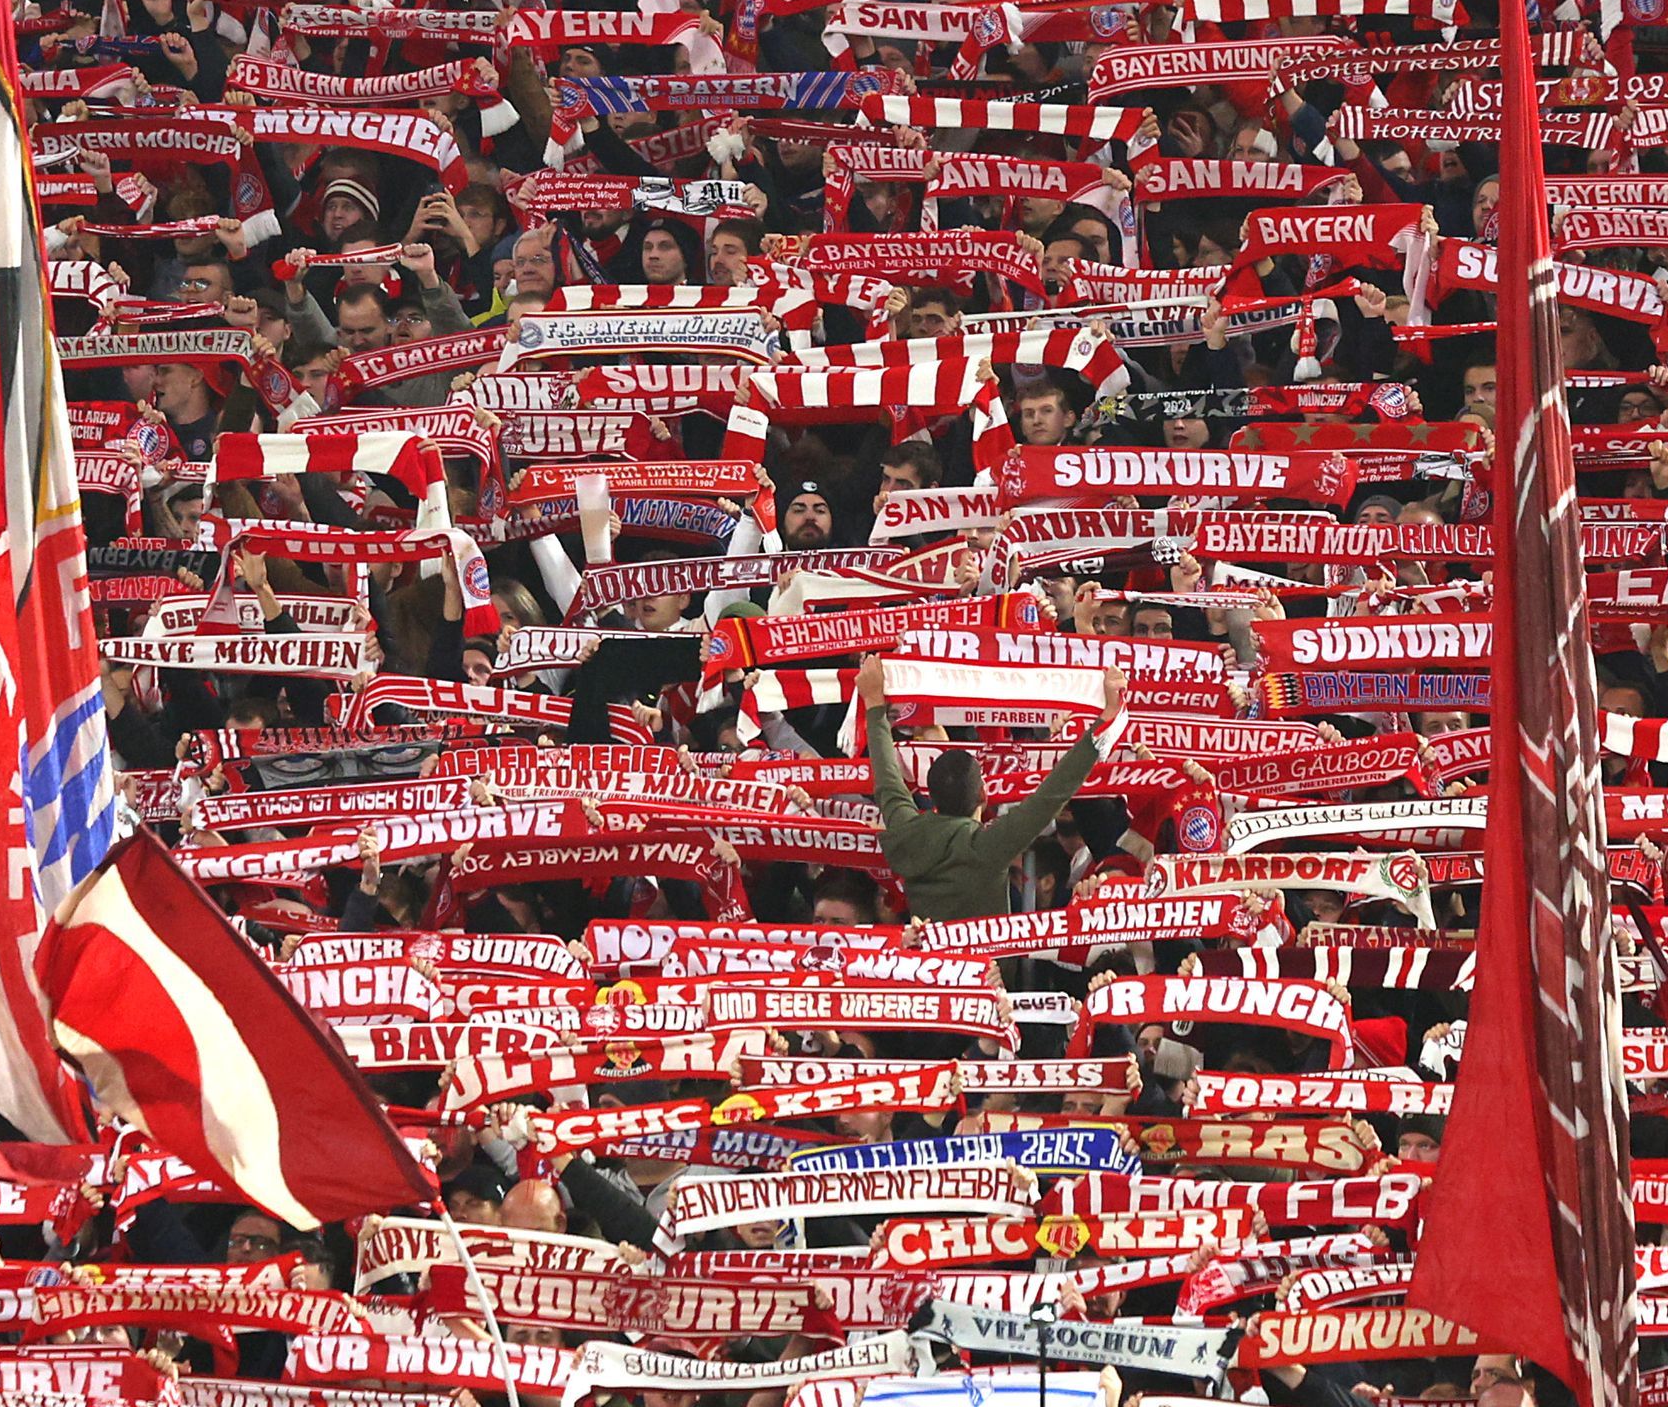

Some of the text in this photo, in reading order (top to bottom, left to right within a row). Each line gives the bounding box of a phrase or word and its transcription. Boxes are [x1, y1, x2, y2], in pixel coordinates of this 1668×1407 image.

[264, 64, 355, 96] BAYERN
[358, 60, 464, 97] MÜNCHEN
[254, 106, 461, 172] MÜNCHEN
[1008, 164, 1068, 192] MIA
[1258, 213, 1375, 244] BAYERN
[1563, 215, 1590, 241] FC
[561, 335, 753, 348] DEUTSCHER REKORDMEISTER
[603, 319, 676, 340] BAYERN
[680, 317, 769, 342] MÜNCHEN
[1054, 450, 1294, 490] SÜDKURVE
[214, 640, 362, 670] MÜNCHEN
[756, 763, 871, 783] SUPER REDS
[1299, 773, 1387, 789] NIEDERBAYERN
[1176, 858, 1371, 892] KLARDORF
[1080, 897, 1223, 932] MÜNCHEN
[713, 990, 924, 1023] UND SEELE UNSERES
[1022, 1133, 1096, 1166] ZEISS
[724, 1179, 774, 1214] DEN
[777, 1170, 906, 1208] MODERNEN
[1052, 1327, 1176, 1363] BOCHUM
